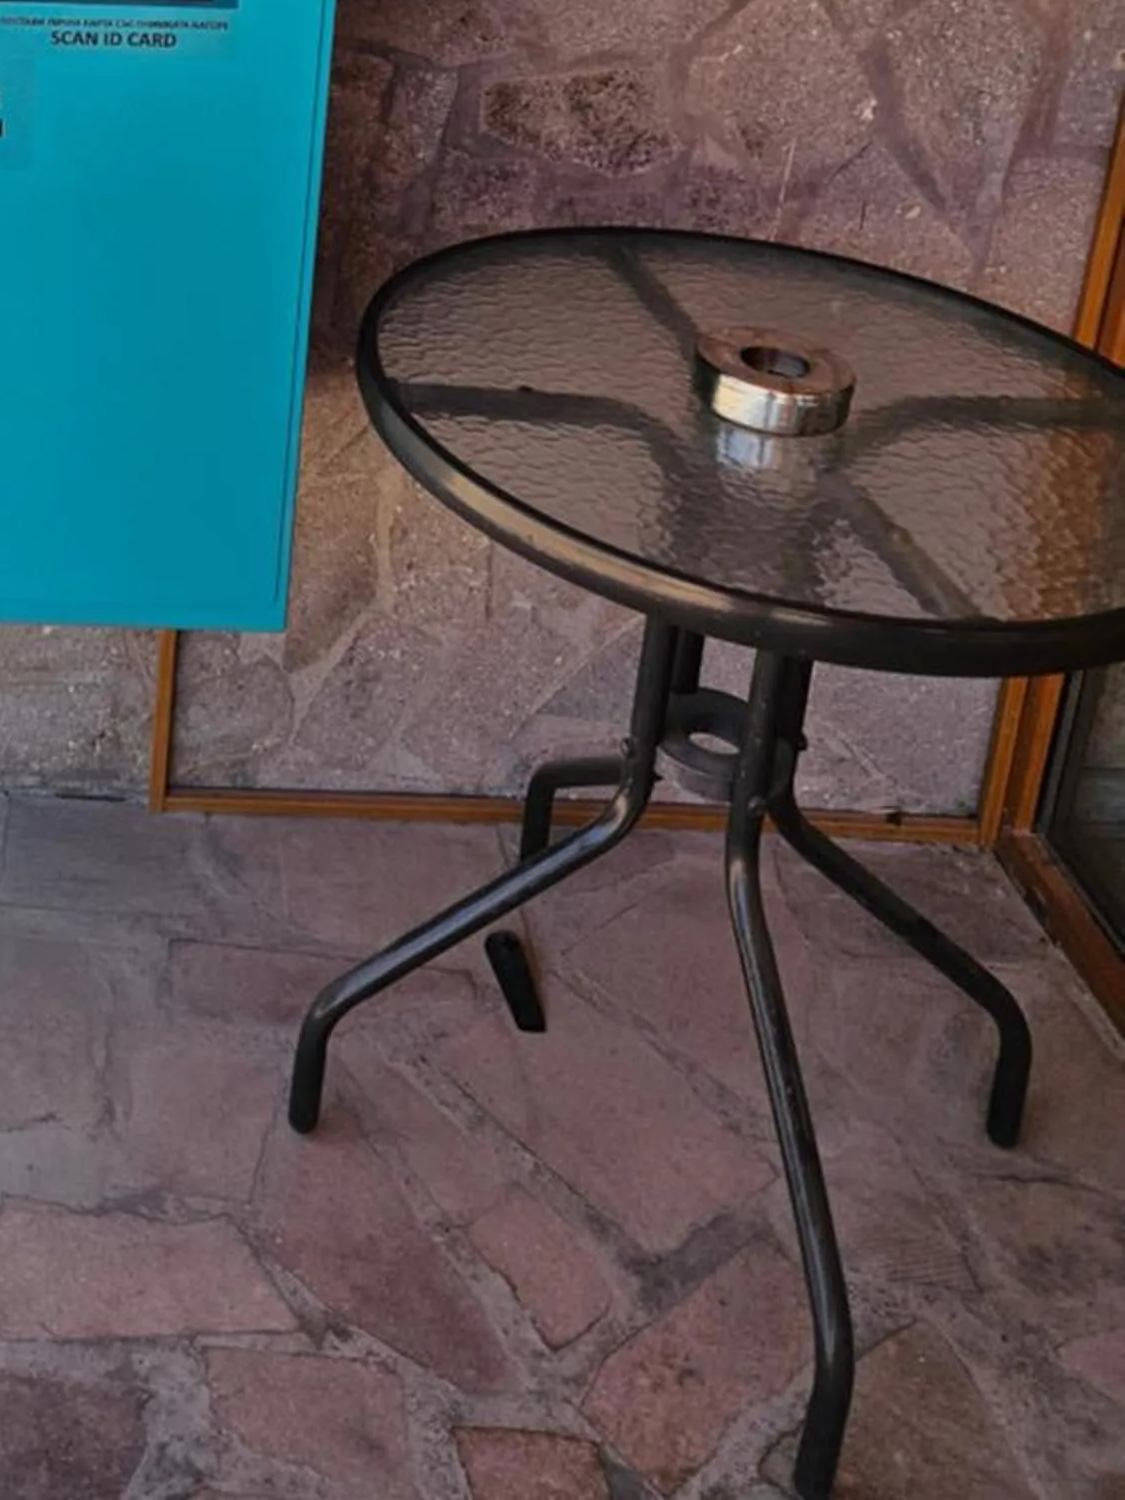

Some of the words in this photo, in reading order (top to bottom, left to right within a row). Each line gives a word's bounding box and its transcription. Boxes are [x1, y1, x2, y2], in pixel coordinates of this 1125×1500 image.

[51, 30, 98, 46] SCAN
[104, 31, 122, 47] ID
[127, 31, 177, 48] CARD
